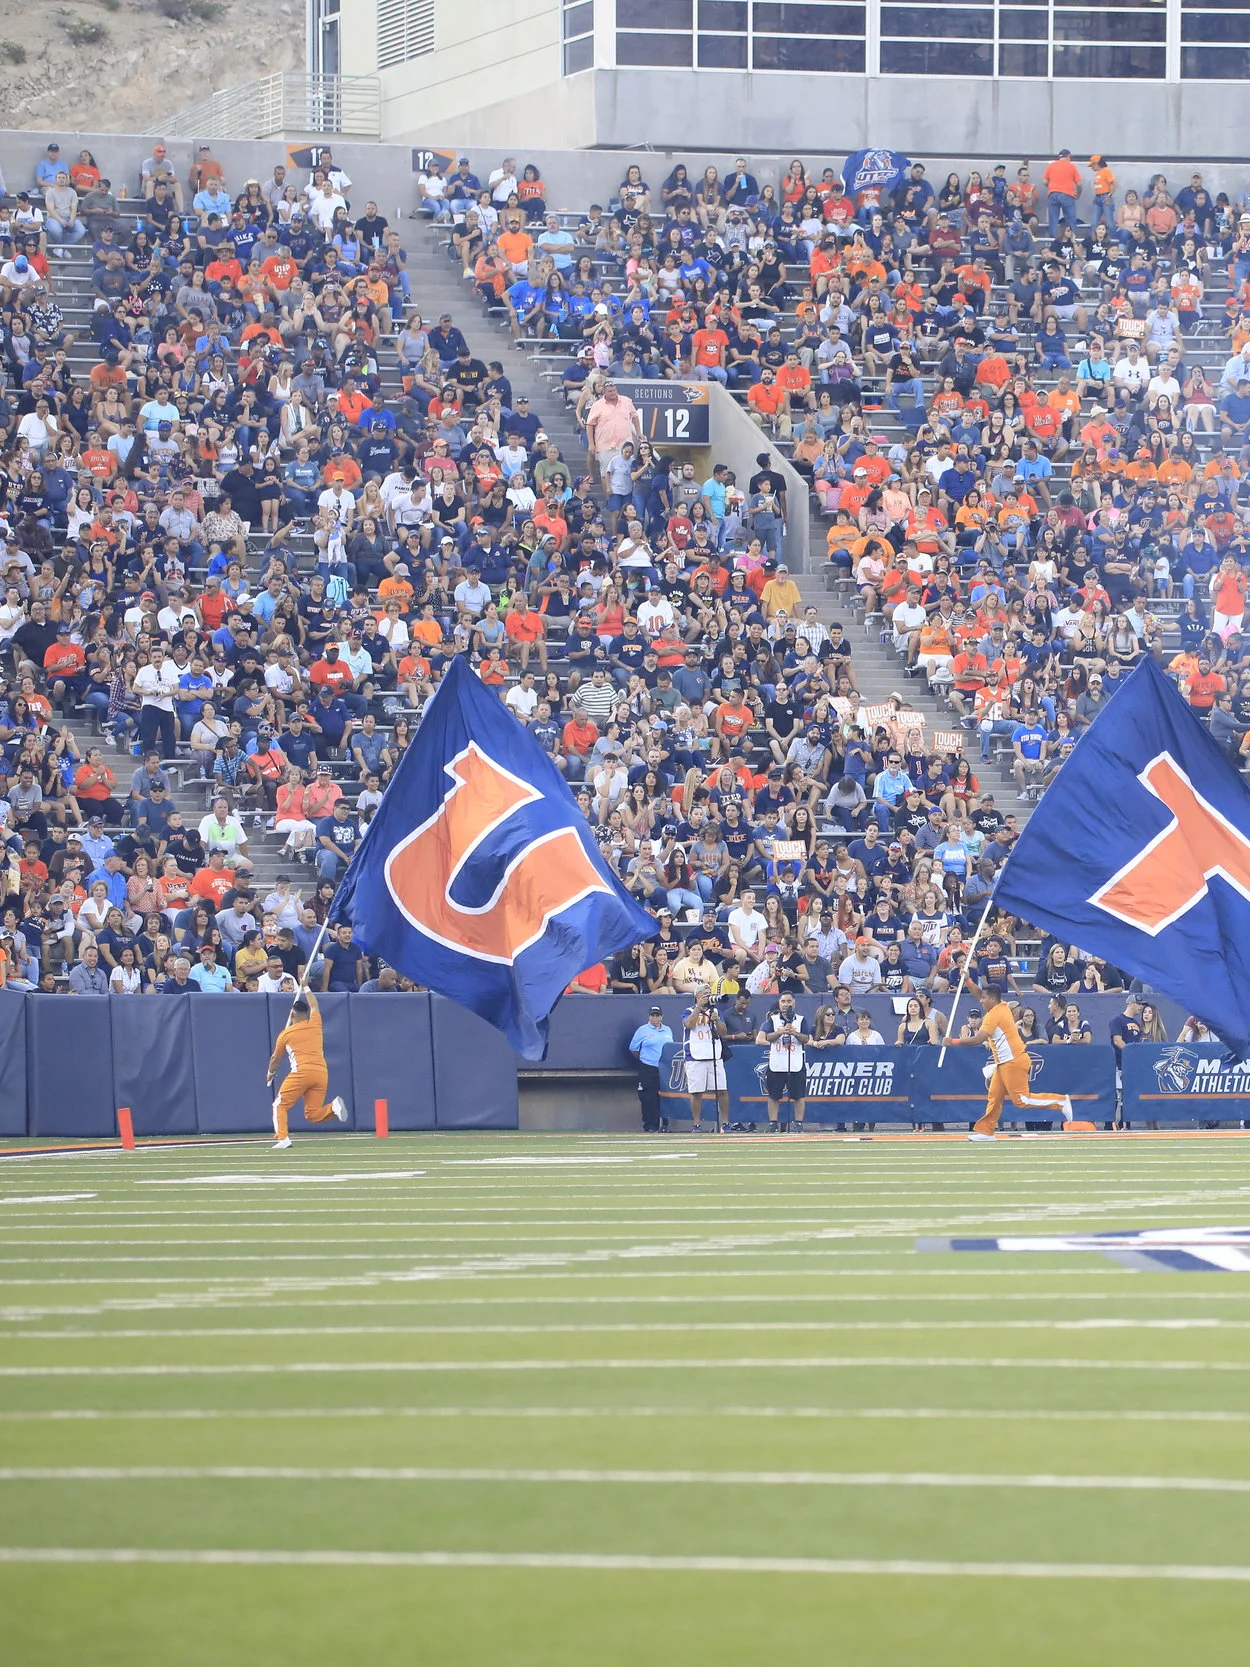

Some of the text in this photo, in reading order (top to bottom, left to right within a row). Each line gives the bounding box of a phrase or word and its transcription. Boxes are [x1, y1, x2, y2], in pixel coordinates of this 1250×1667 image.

[1119, 318, 1145, 331] TOUCH
[634, 389, 673, 399] SECTIONS
[664, 408, 690, 437] 12
[649, 616, 663, 631] 10
[866, 703, 895, 719] TOUCH
[896, 711, 925, 723] TOUCH
[934, 731, 962, 746] TOUCH
[934, 744, 957, 752] DOWN!
[916, 761, 923, 774] 1
[384, 740, 616, 967] U
[773, 842, 804, 852] TOUCH
[166, 882, 187, 890] UTEP
[805, 1062, 895, 1077] MINER
[857, 1078, 893, 1096] CLUB
